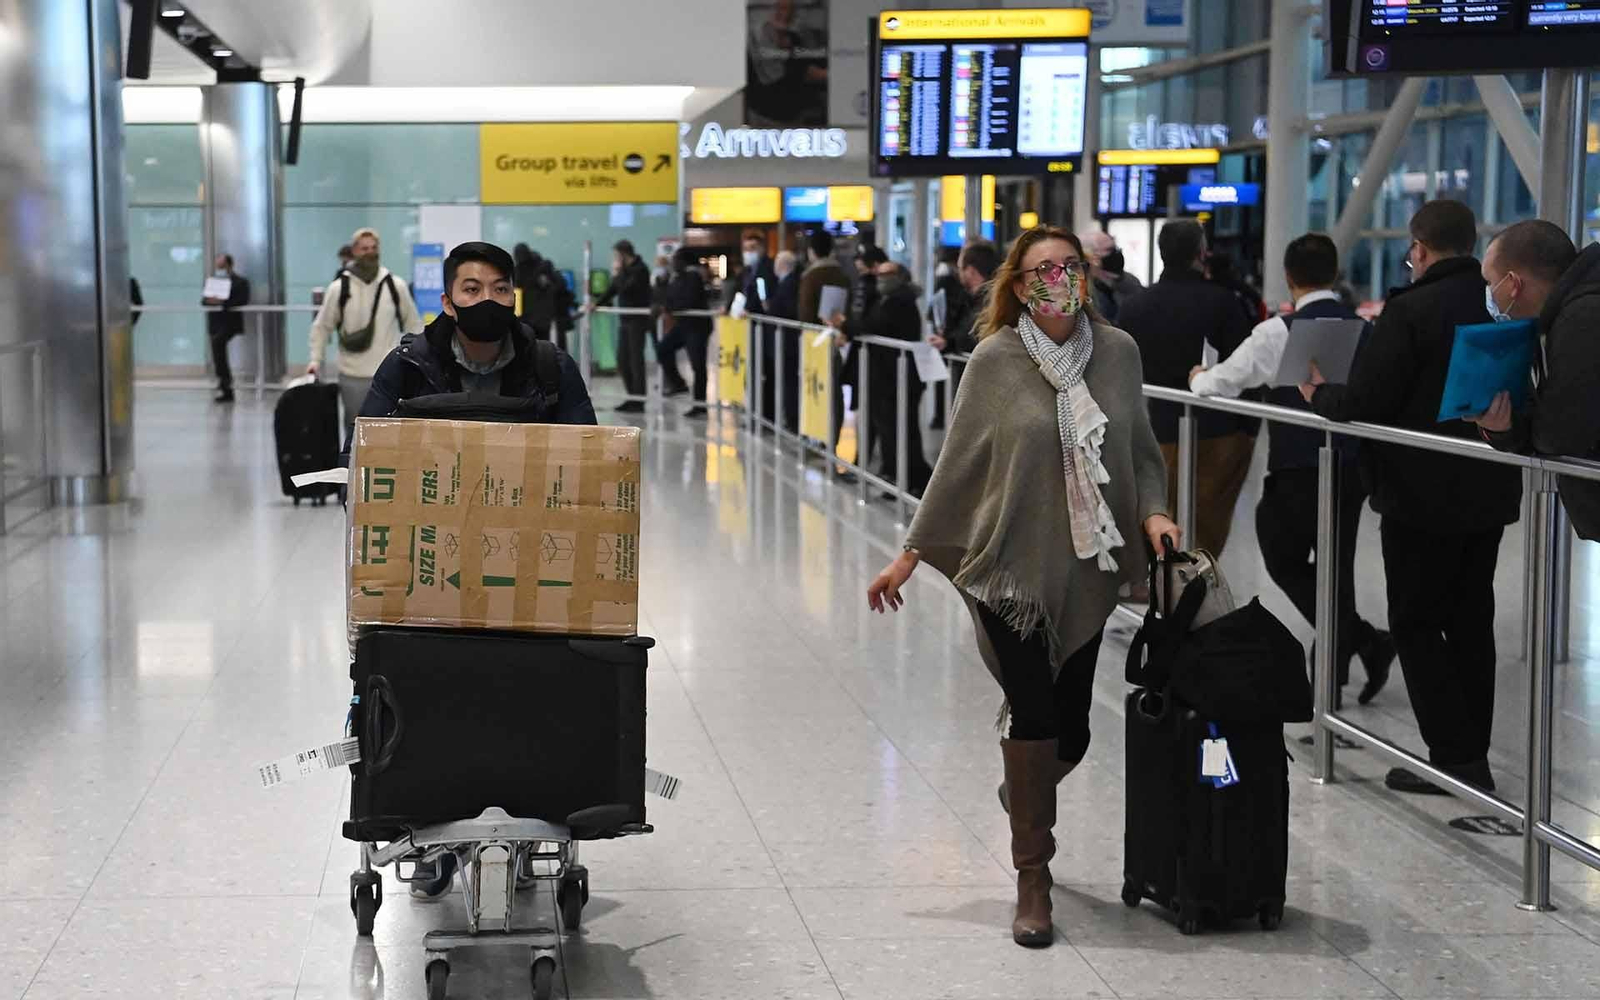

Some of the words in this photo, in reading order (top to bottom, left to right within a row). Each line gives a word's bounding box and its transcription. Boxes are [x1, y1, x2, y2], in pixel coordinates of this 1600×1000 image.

[695, 122, 847, 158] Arrivals
[495, 153, 557, 174] Group
[562, 153, 619, 171] travel
[564, 175, 586, 188] via
[590, 175, 618, 188] lifts
[419, 547, 436, 587] SIZE
